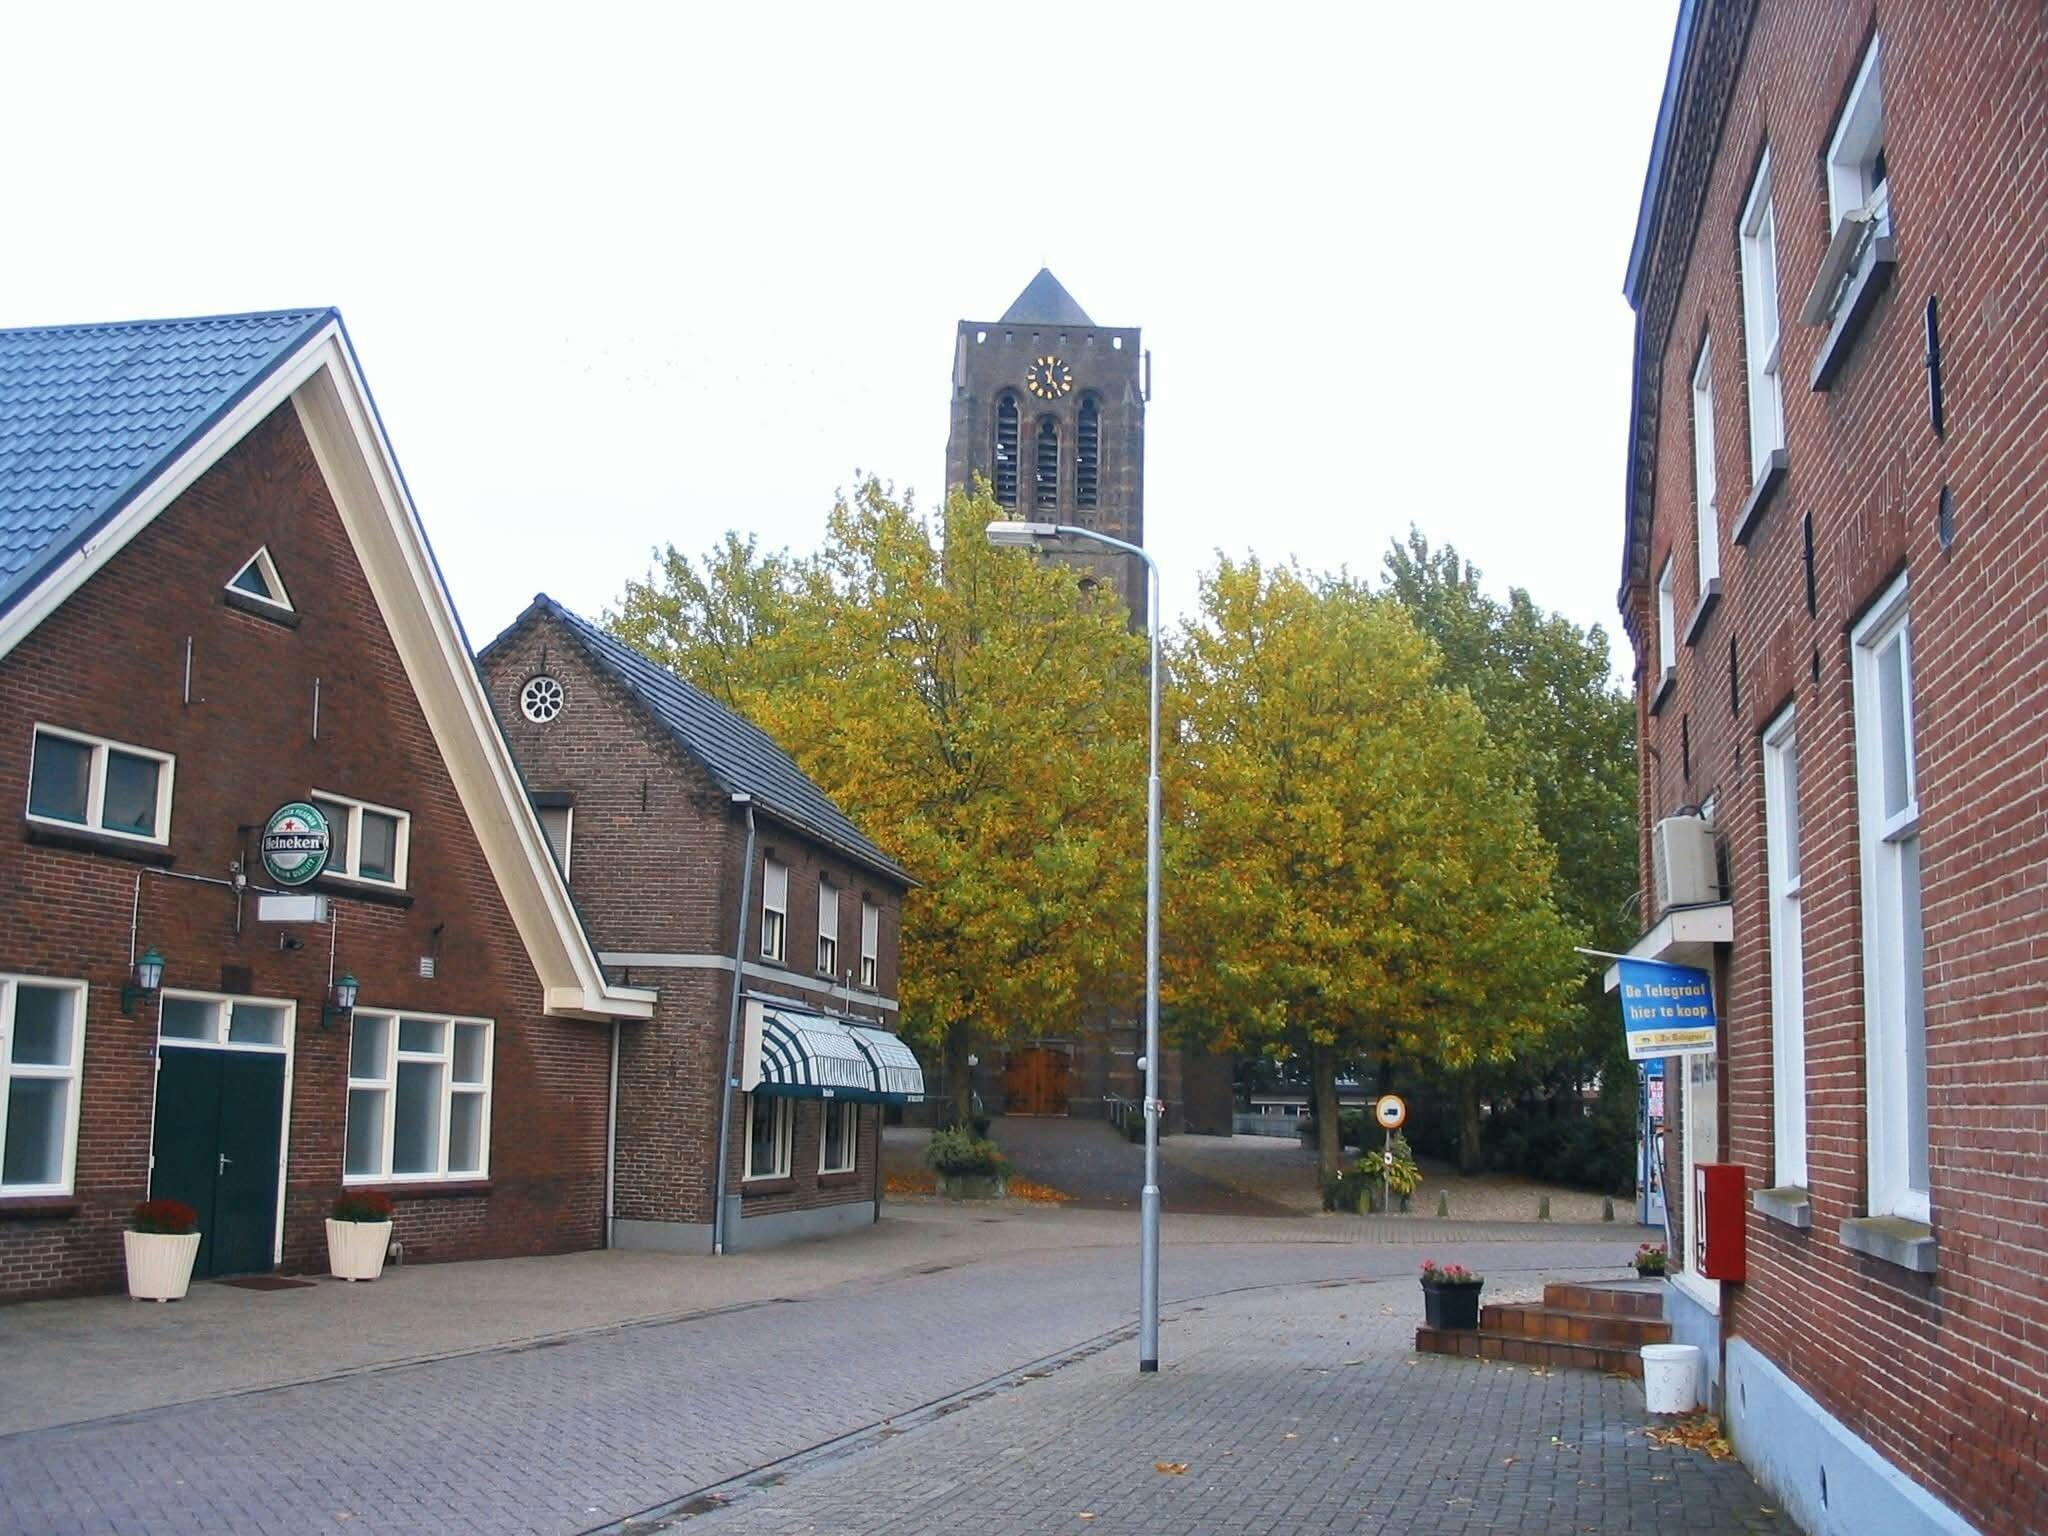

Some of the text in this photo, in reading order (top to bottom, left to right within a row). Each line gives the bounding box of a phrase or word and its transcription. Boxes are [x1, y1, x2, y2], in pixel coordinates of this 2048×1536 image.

[265, 836, 320, 850] Heineken
[1625, 983, 1705, 999] De Telegraaf
[1630, 1003, 1708, 1019] hier te koop
